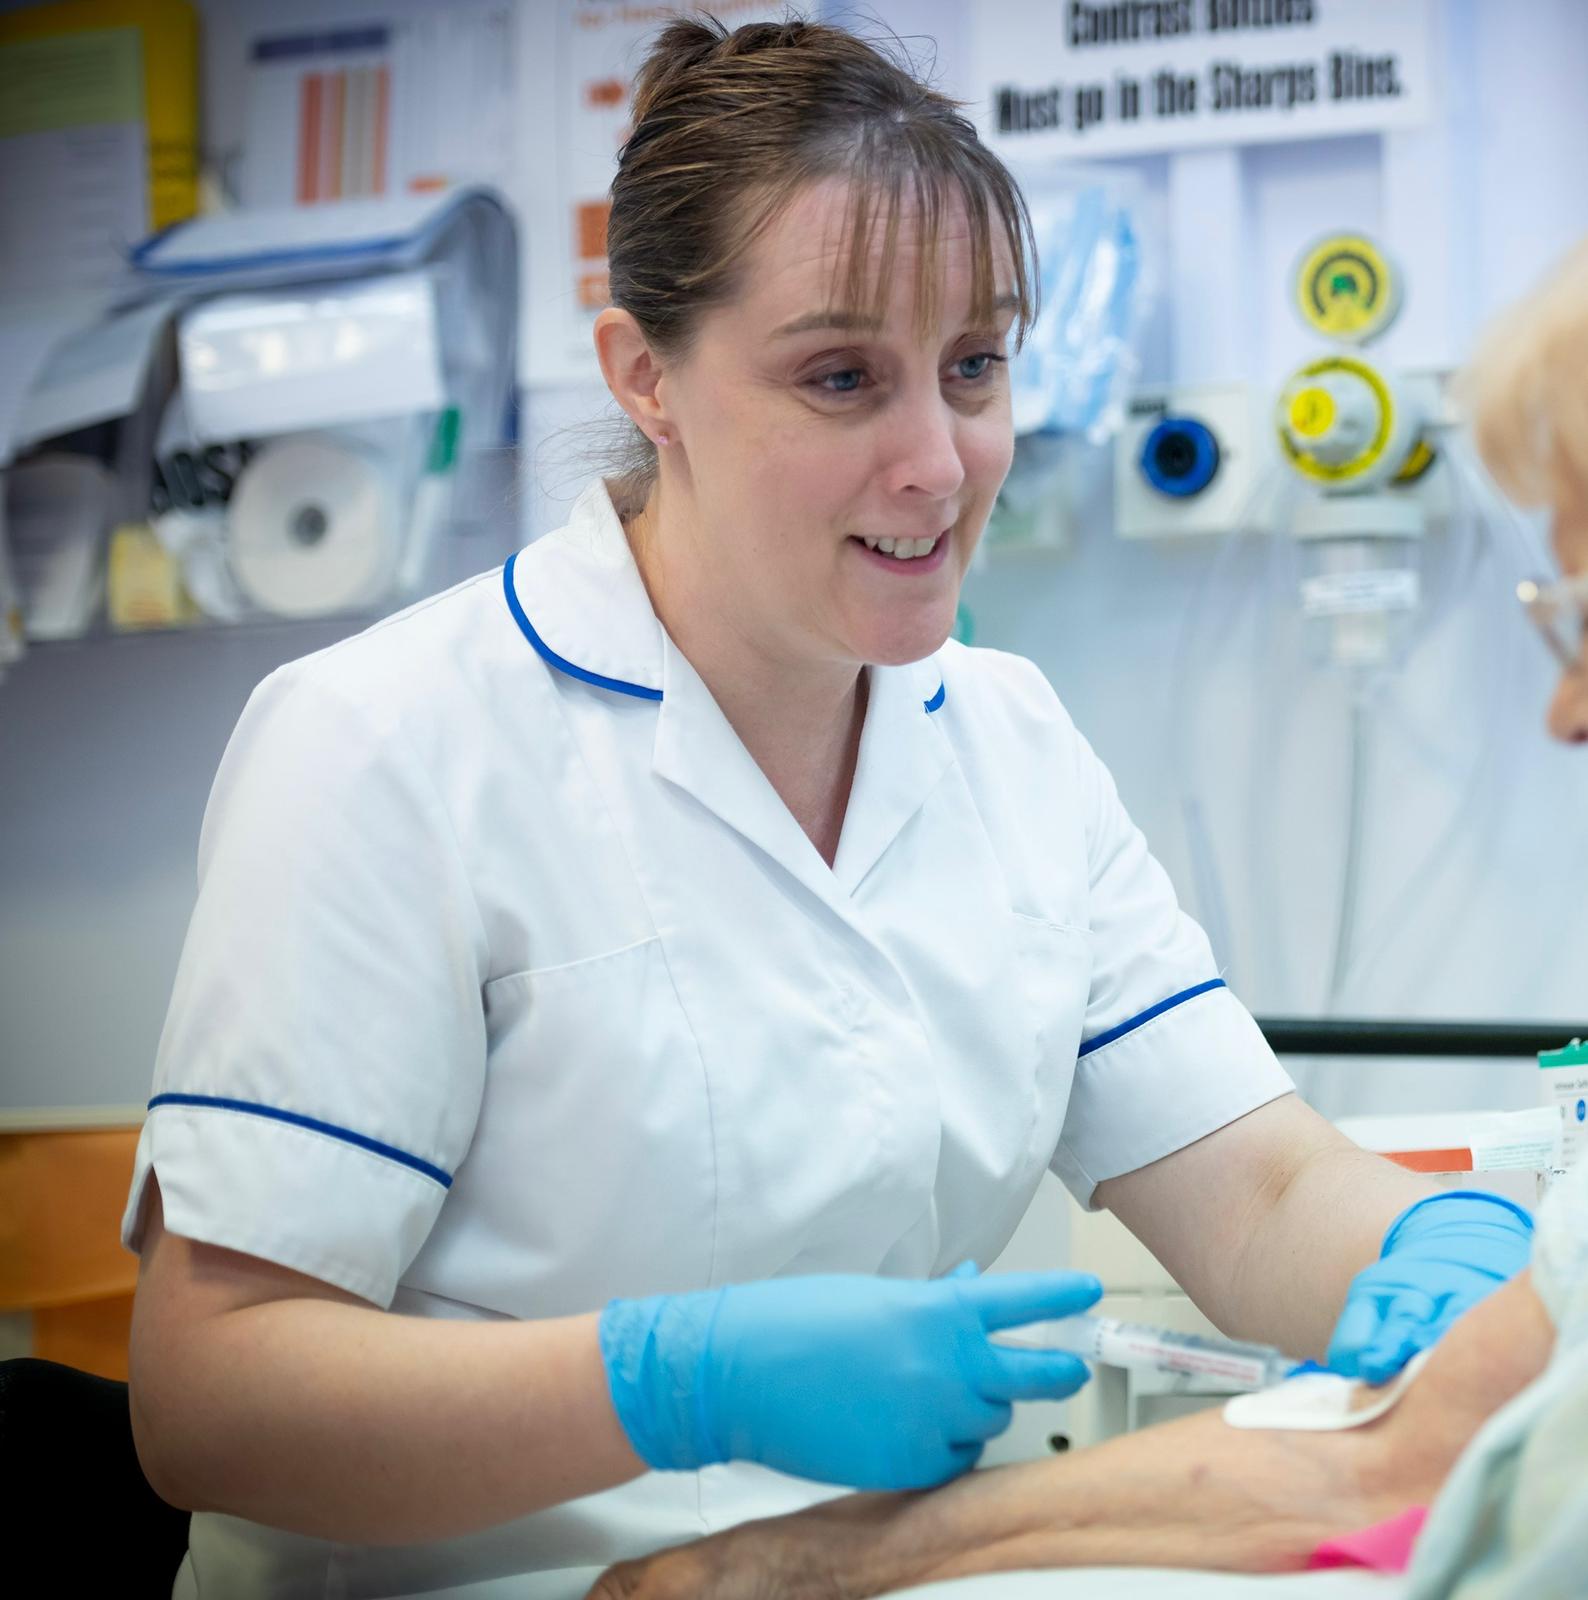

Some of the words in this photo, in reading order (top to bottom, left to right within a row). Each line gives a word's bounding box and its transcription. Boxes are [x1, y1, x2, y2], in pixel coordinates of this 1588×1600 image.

[1069, 0, 1192, 46] Contrast
[996, 86, 1060, 134] Must
[1075, 86, 1104, 132] go
[1119, 76, 1139, 120] in
[1155, 70, 1196, 117] the
[1212, 62, 1316, 111] Sharps
